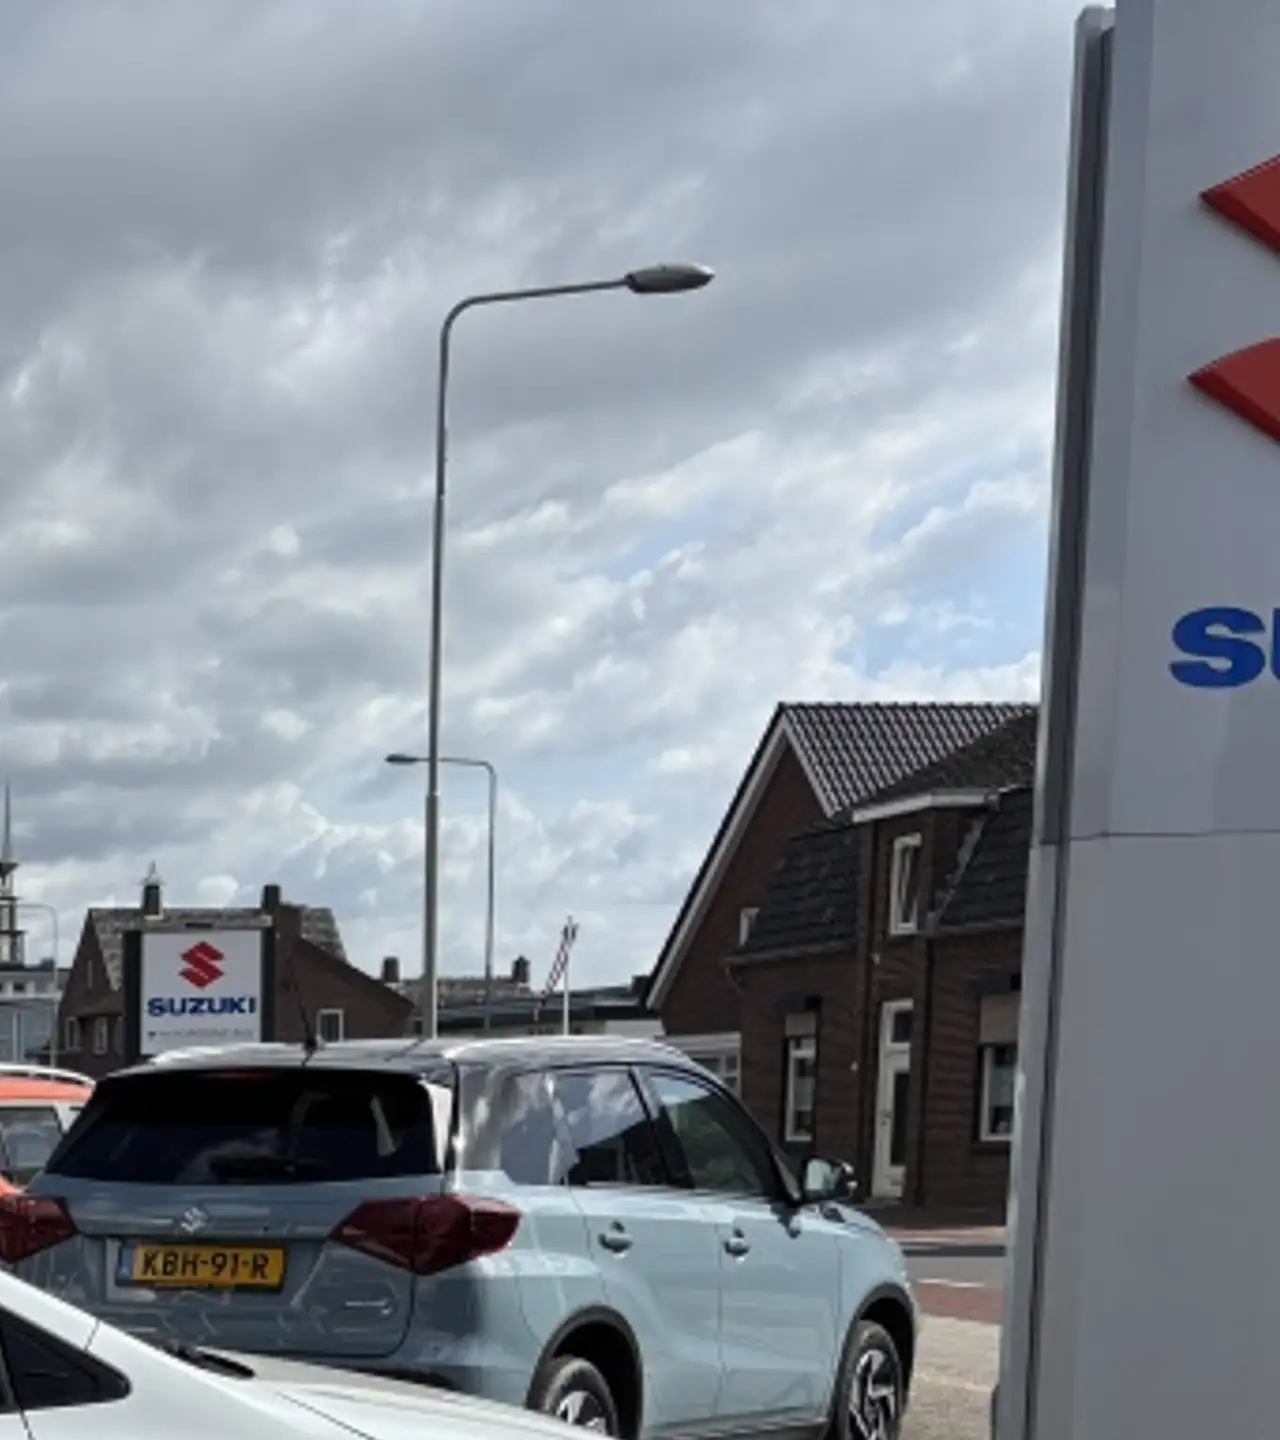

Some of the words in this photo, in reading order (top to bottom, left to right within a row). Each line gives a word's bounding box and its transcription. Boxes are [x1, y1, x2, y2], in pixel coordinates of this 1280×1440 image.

[1169, 607, 1280, 688] S
[147, 997, 257, 1017] SUZUKI
[141, 1250, 270, 1280] KBH-91-R
